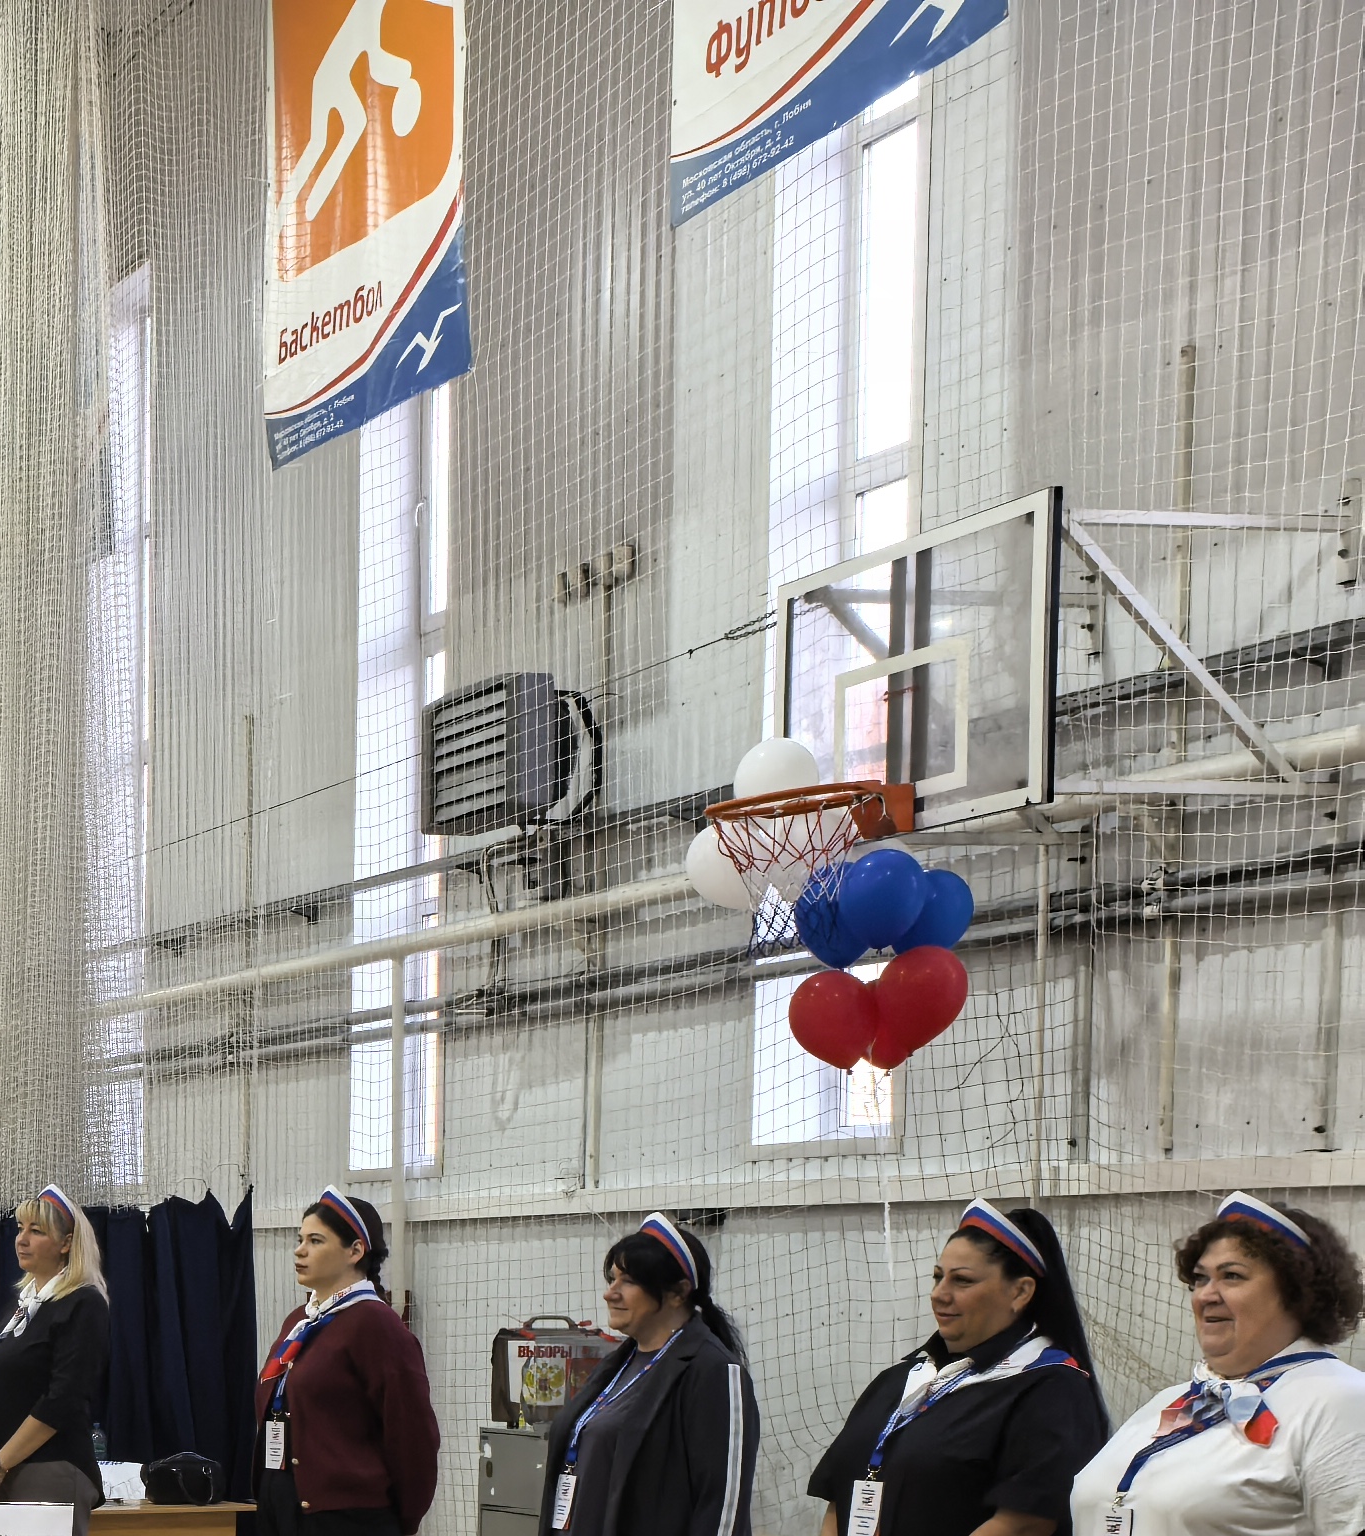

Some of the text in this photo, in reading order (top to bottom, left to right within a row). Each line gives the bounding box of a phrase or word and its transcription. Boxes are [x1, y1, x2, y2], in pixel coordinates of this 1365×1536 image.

[705, 0, 823, 78] Фут
[775, 130, 782, 141] 2
[277, 280, 383, 366] Баскетбол
[517, 1345, 573, 1359] ВЫБОРЫ
